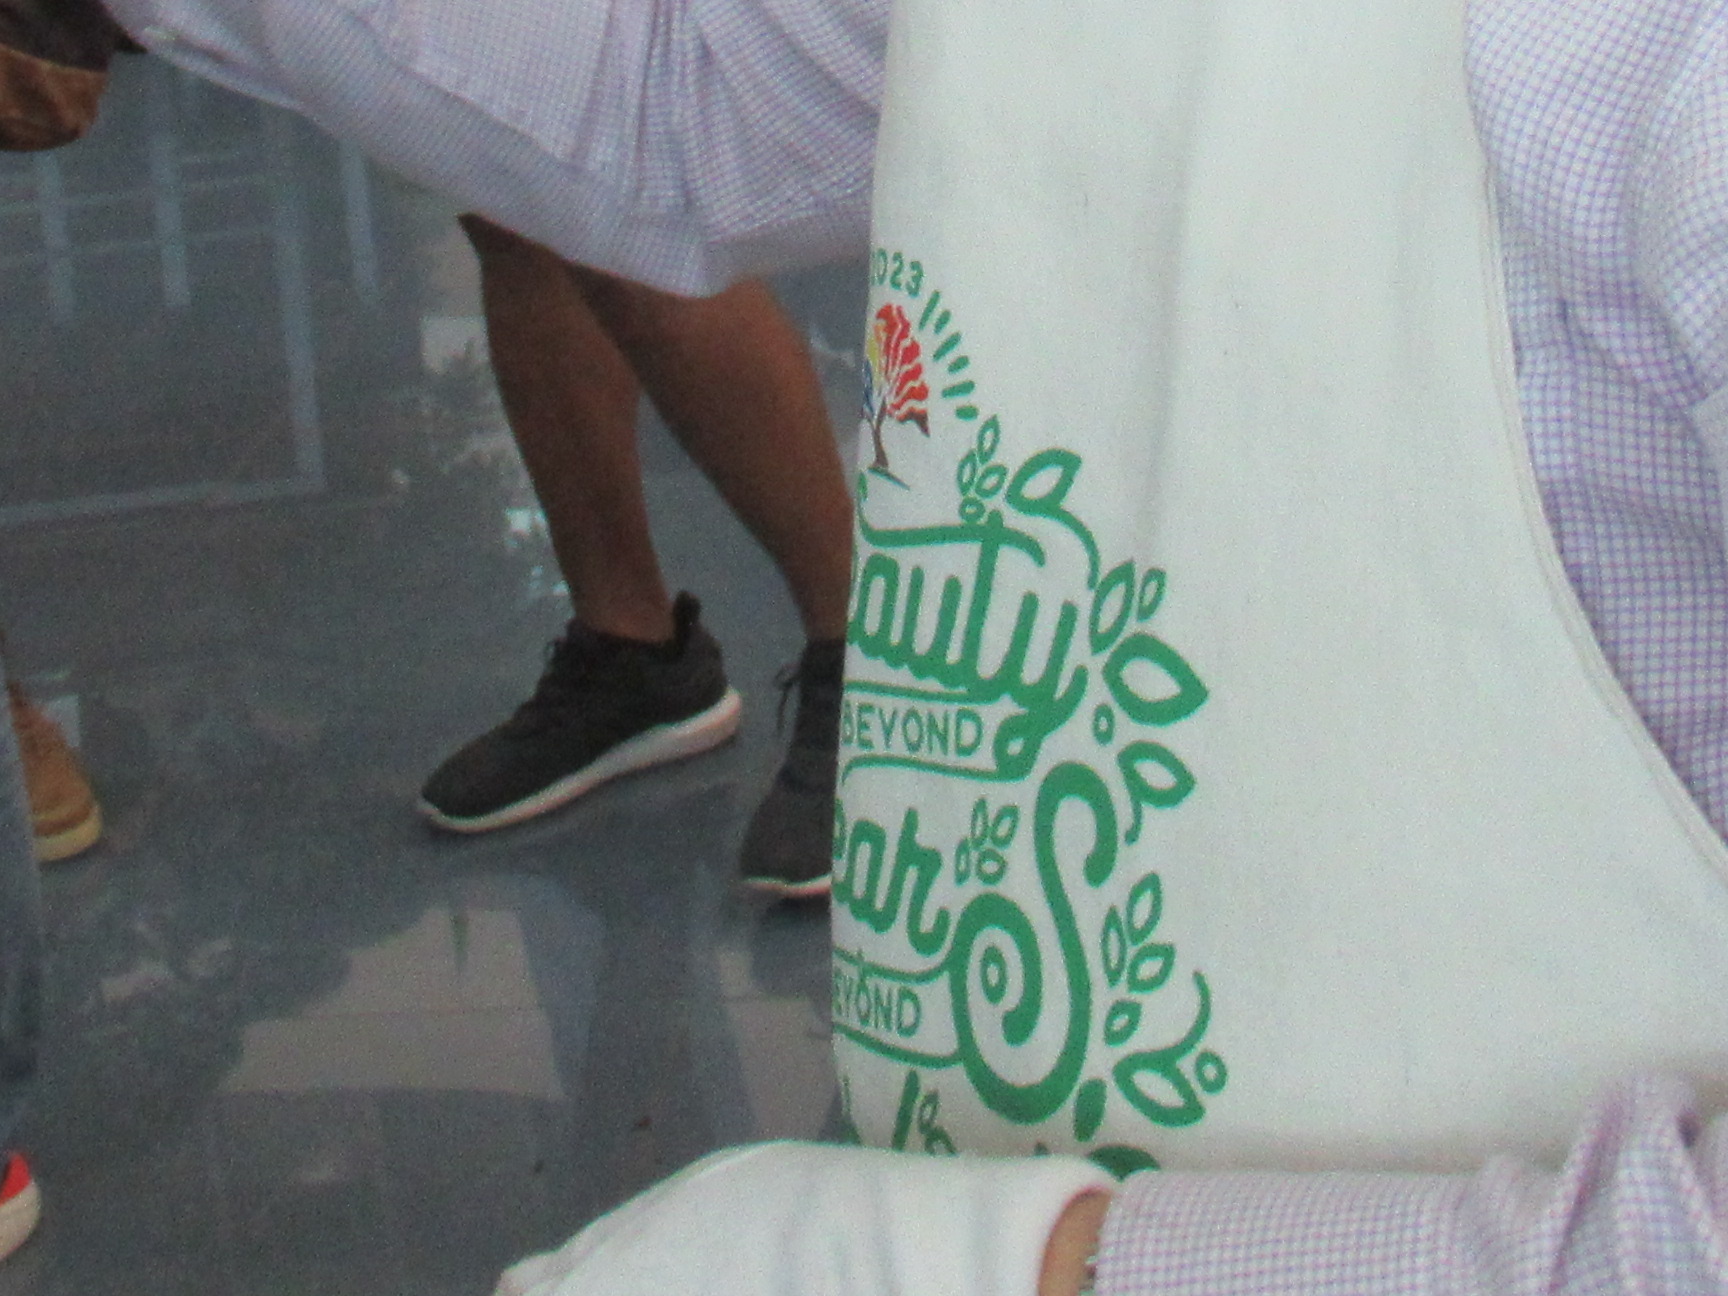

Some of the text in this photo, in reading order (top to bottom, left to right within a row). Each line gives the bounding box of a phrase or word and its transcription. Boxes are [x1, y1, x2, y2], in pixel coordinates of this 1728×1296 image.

[871, 247, 924, 298] 023
[845, 509, 1088, 782] auty
[841, 699, 984, 758] BEYOND
